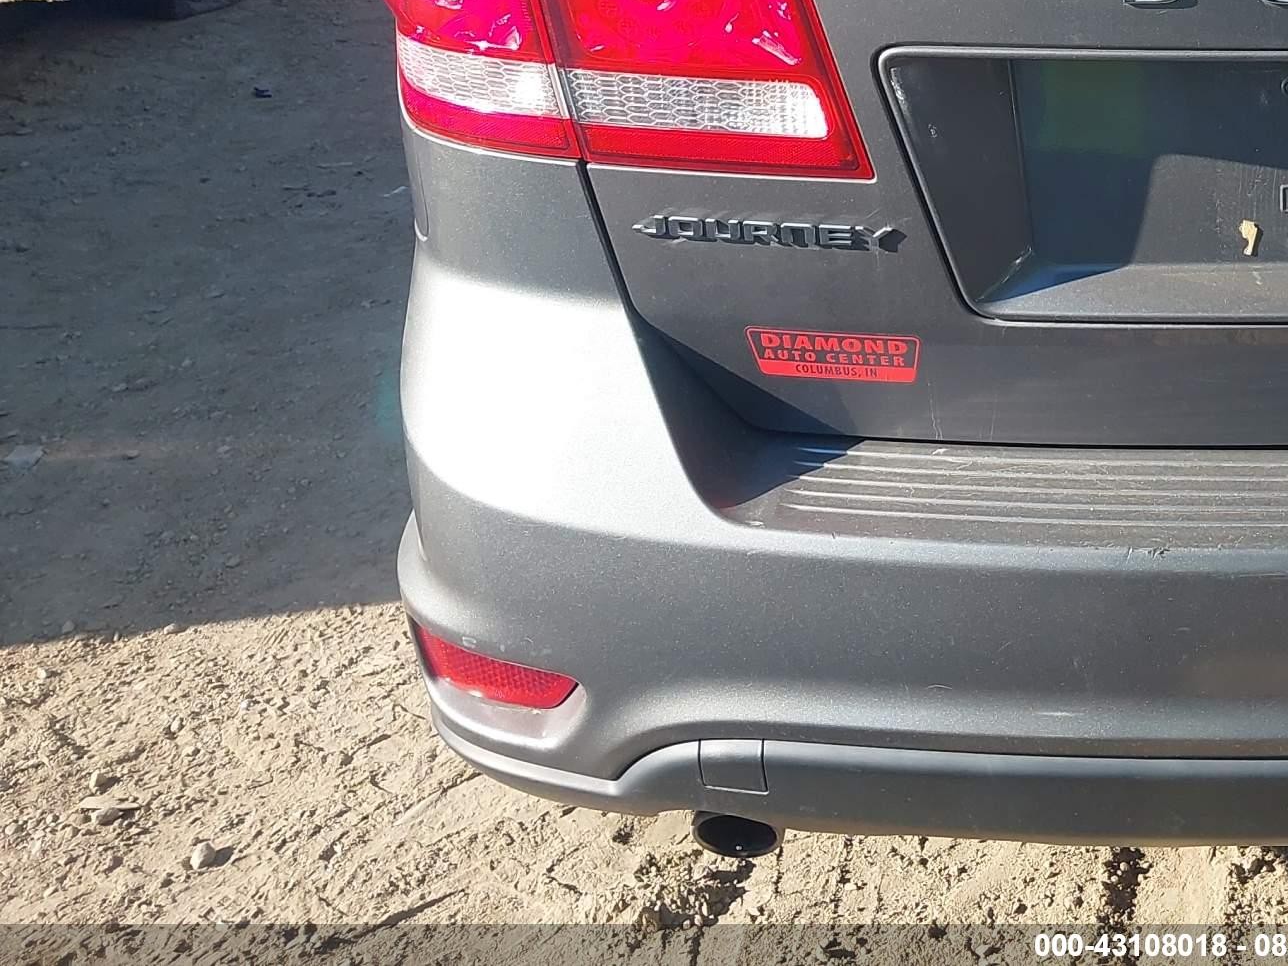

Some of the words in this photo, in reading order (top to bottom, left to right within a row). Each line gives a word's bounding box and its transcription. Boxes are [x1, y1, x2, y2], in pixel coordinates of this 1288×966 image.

[631, 214, 906, 252] JOURNEY
[760, 333, 908, 355] DIAMOND
[763, 348, 816, 362] AUTO
[825, 352, 905, 366] CENTER
